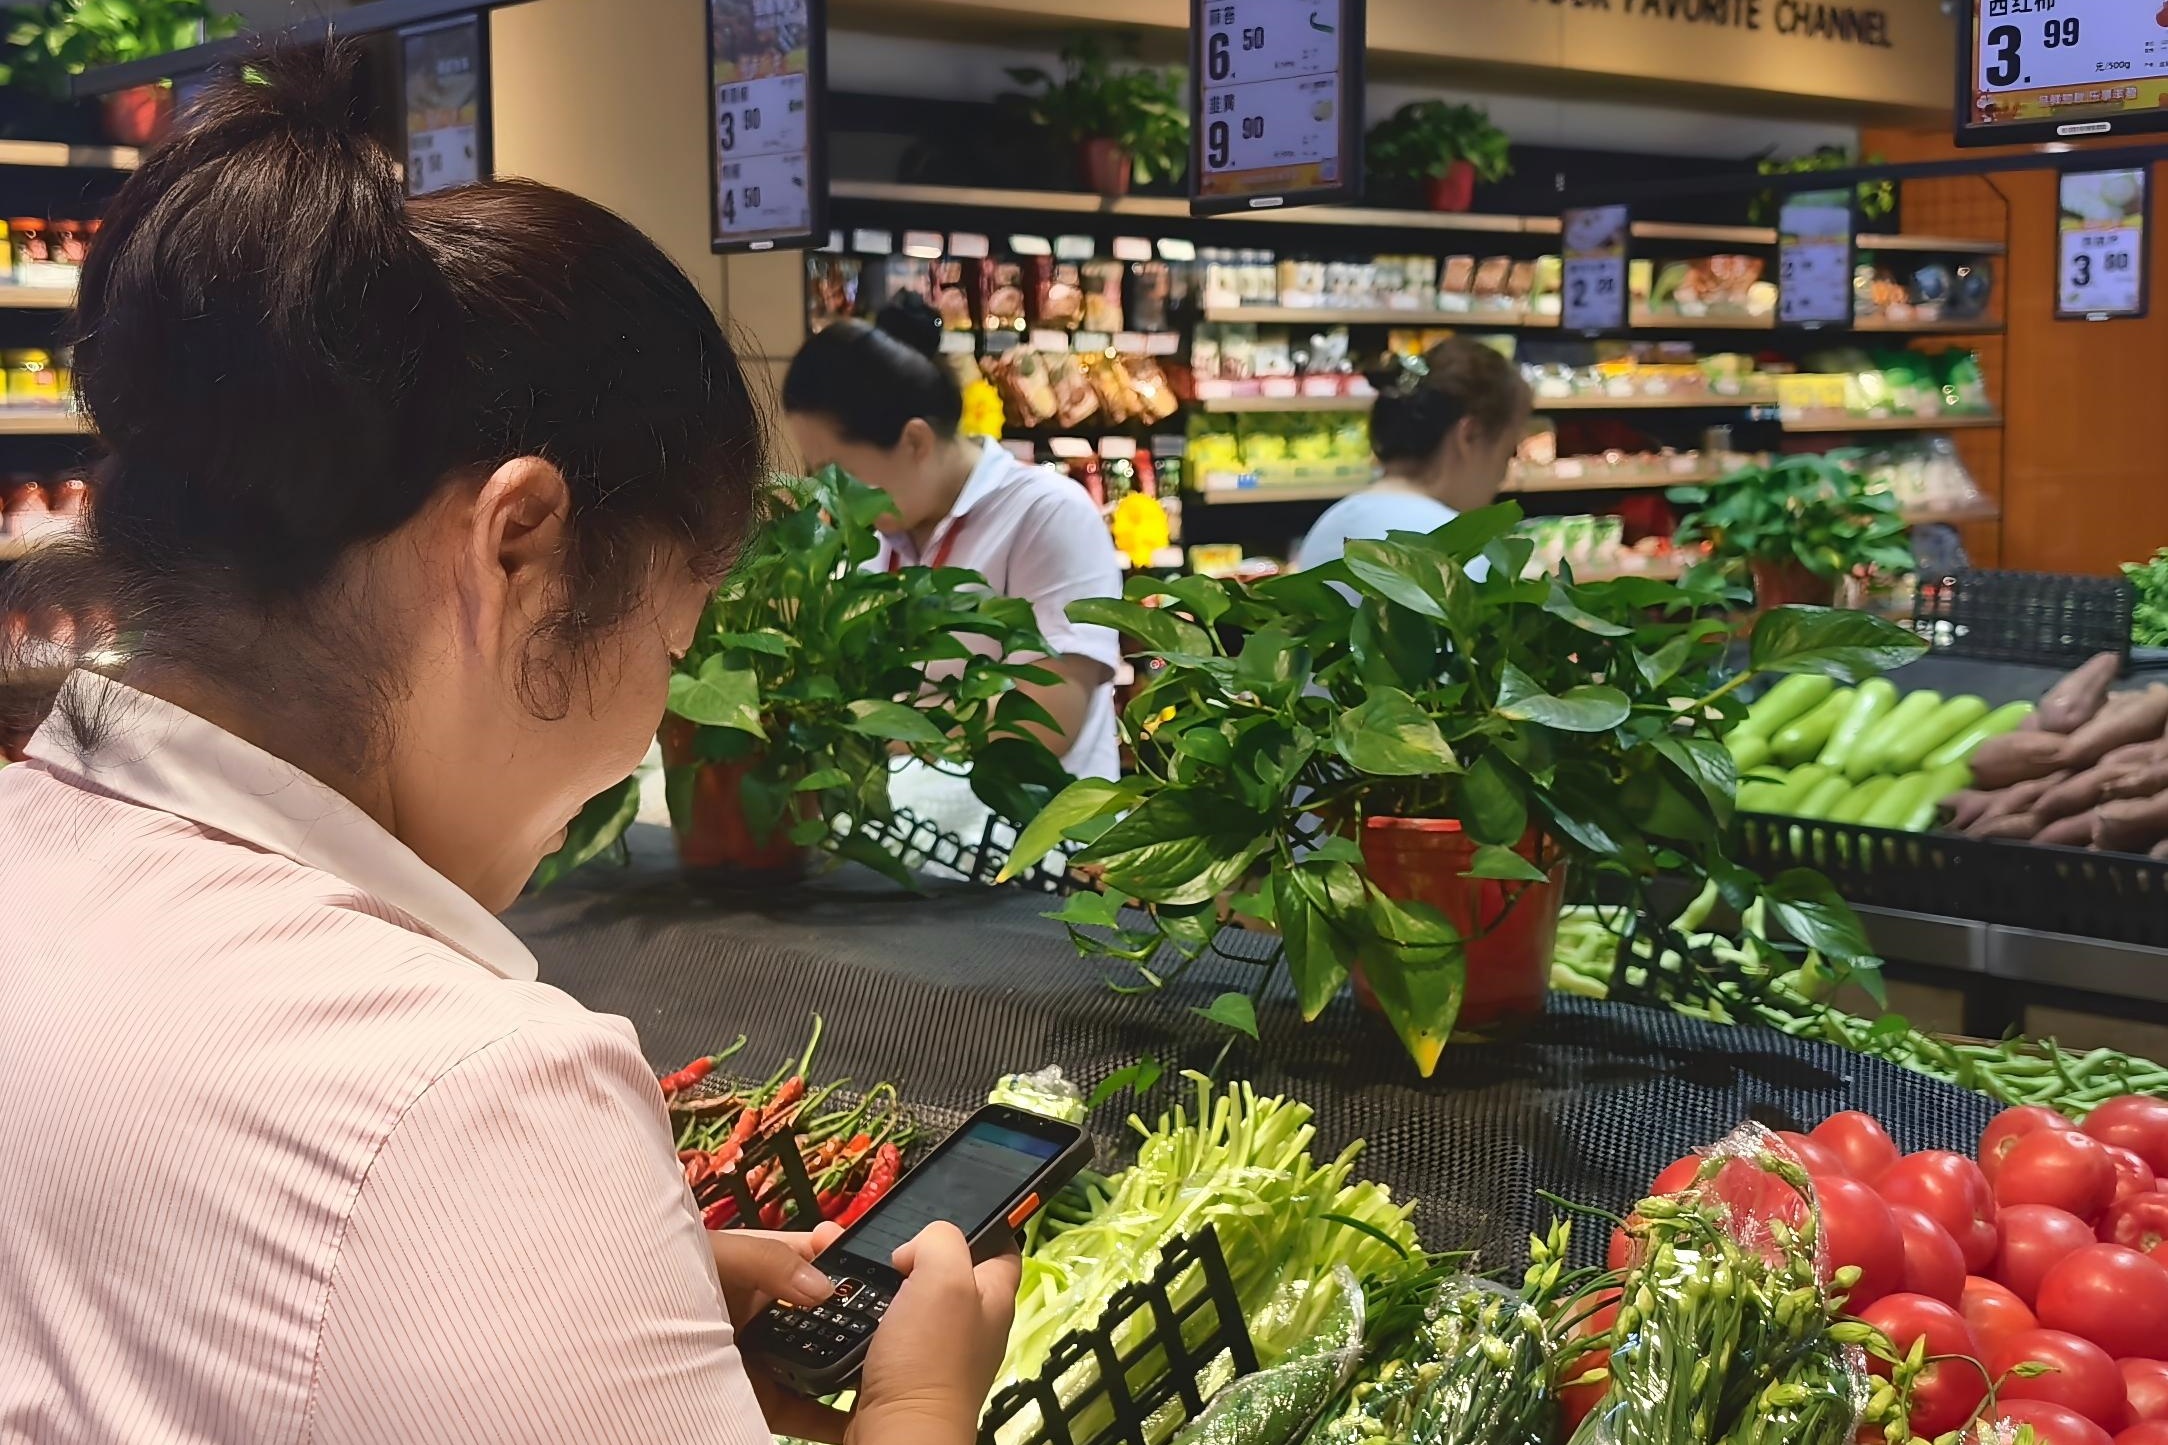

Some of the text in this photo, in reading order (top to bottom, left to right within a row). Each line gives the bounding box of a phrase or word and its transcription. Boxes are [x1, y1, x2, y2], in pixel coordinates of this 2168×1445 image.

[1242, 26, 1265, 51] 50
[1774, 0, 1893, 49] CHANNEL
[2043, 17, 2080, 49] 99
[721, 111, 735, 151] 3
[723, 188, 737, 226] 4
[2071, 253, 2091, 287] 3
